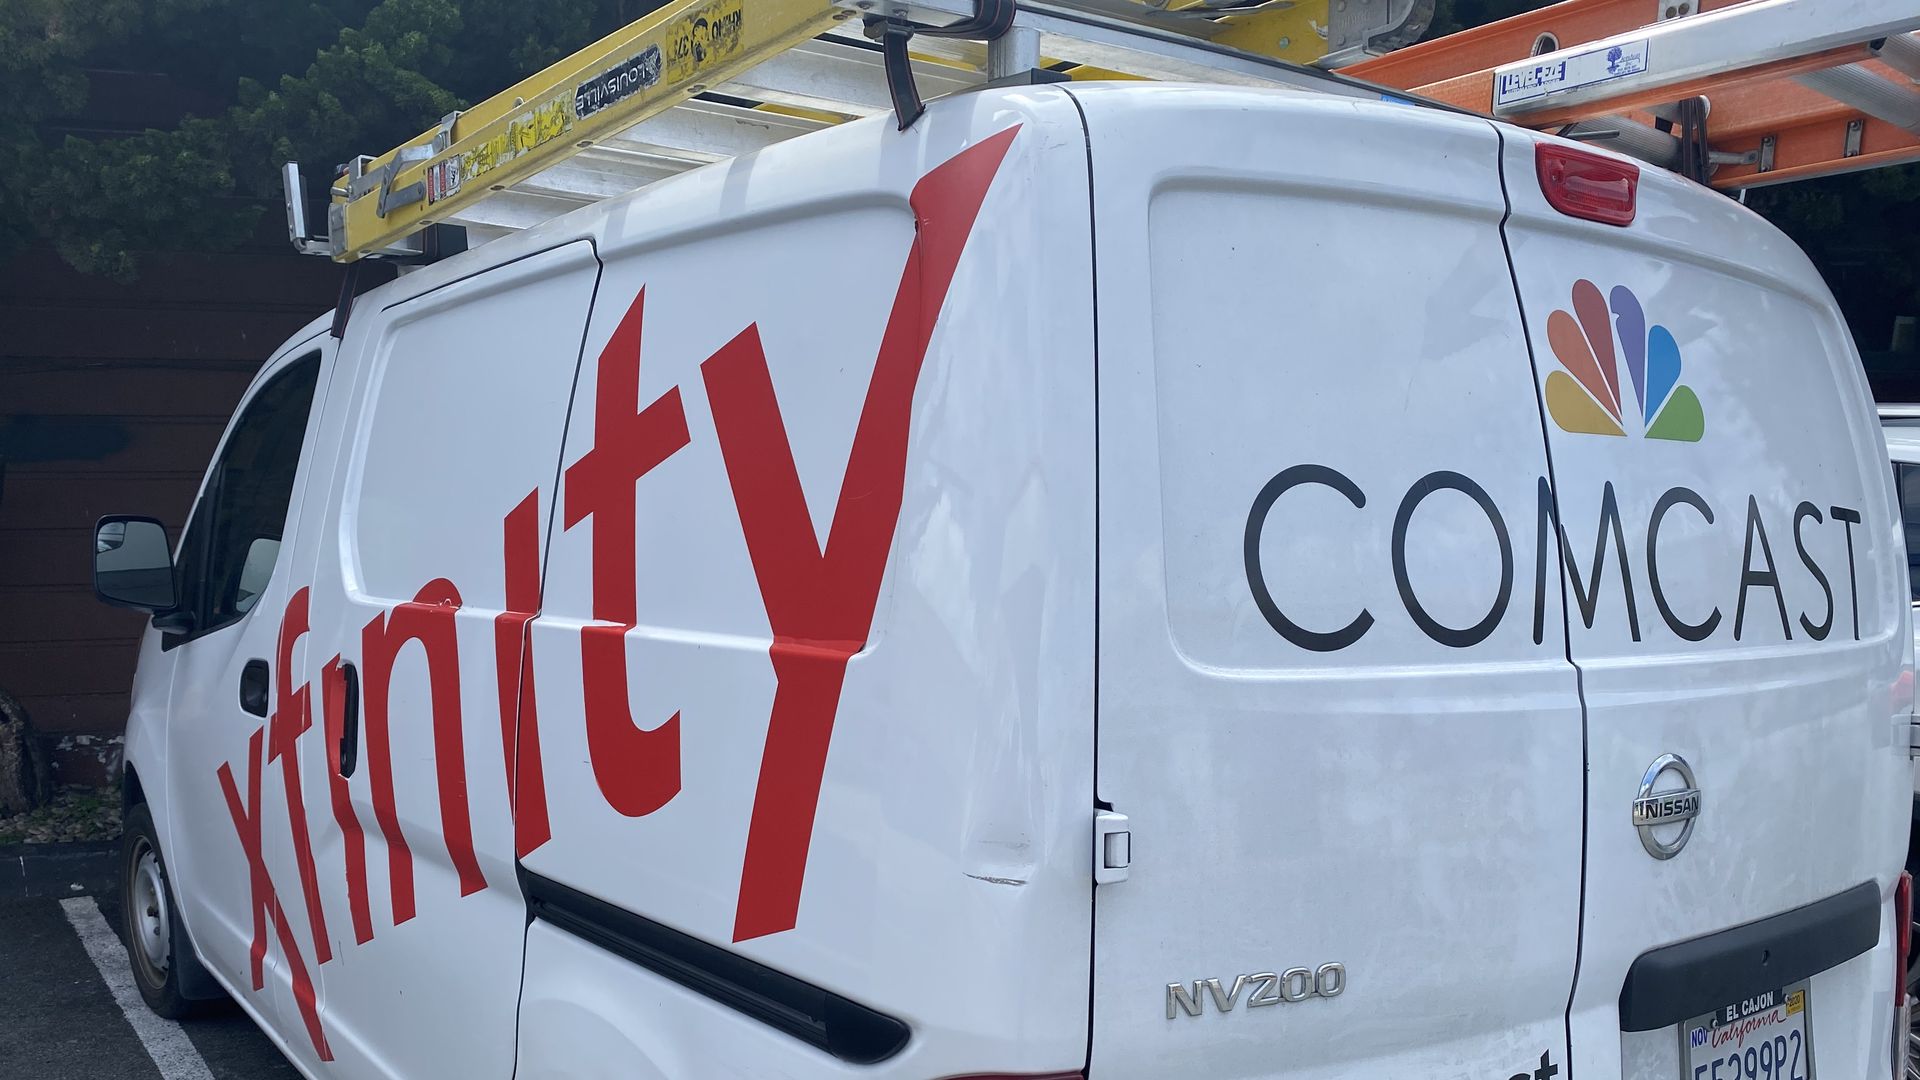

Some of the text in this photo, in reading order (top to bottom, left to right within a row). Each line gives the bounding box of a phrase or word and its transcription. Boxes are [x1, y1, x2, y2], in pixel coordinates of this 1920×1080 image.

[576, 64, 646, 110] LOUISVILLE
[1244, 463, 1862, 652] COMCAST
[217, 123, 1023, 1062] xfinity
[1646, 796, 1699, 819] NISSAN
[1166, 962, 1346, 1019] NV200
[1726, 991, 1774, 1022] EL CAJON
[1691, 1028, 1708, 1048] NOV
[1711, 1008, 1787, 1049] California
